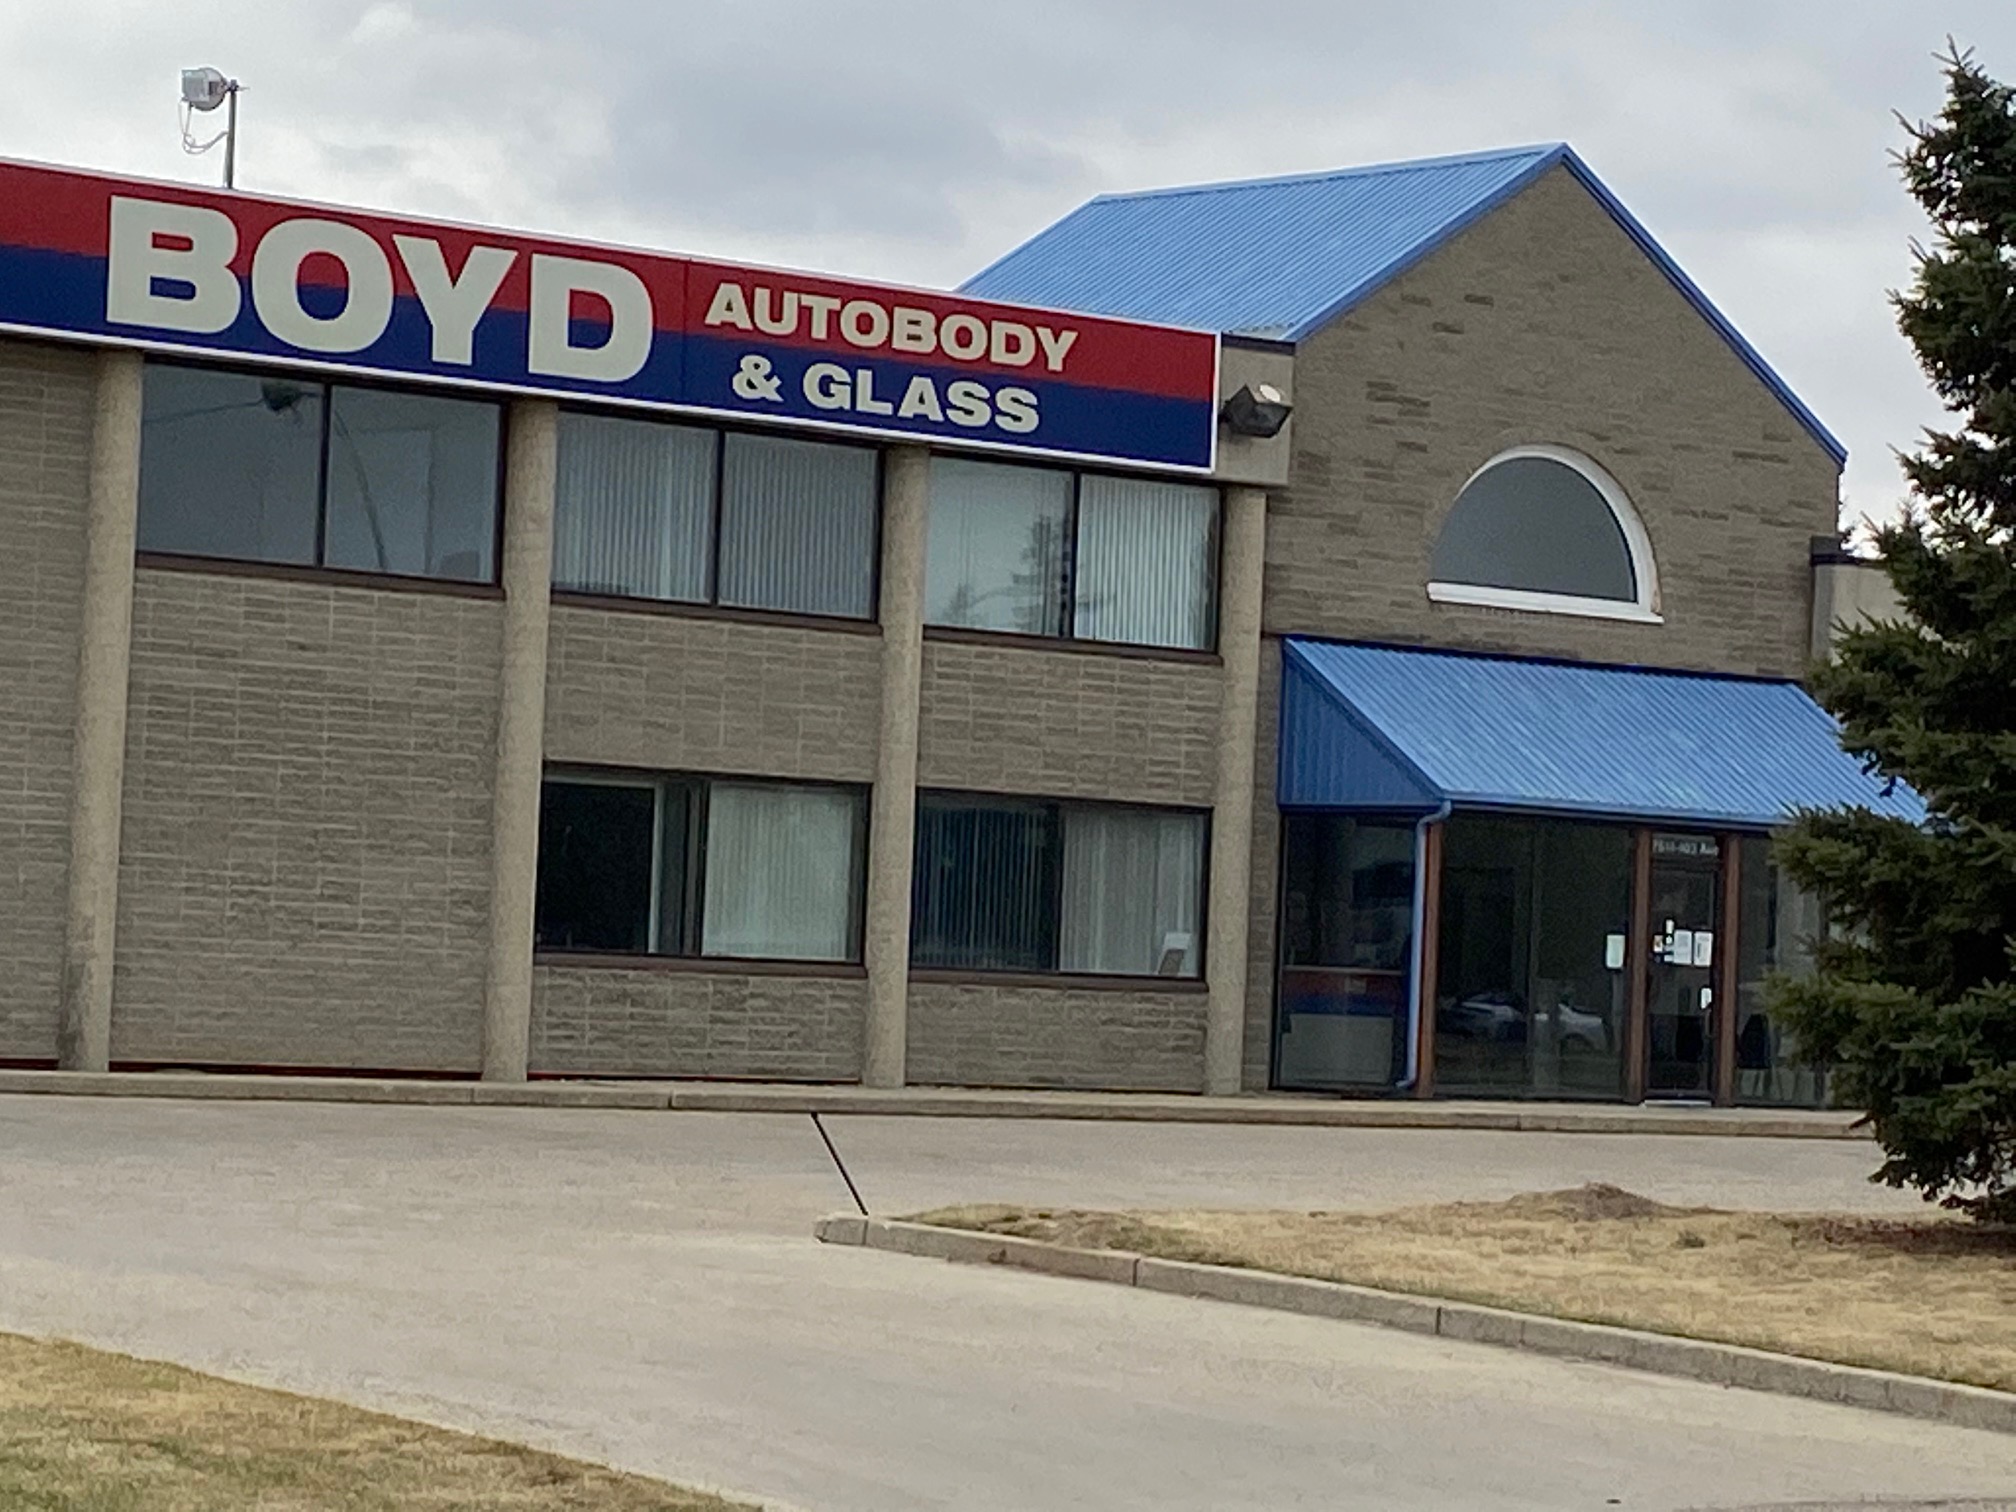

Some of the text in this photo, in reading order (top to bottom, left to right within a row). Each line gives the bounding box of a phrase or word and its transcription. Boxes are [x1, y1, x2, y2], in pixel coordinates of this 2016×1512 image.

[106, 196, 653, 382] BOYD
[706, 284, 1077, 371] AUTOBODY
[732, 356, 1038, 432] & GLASS
